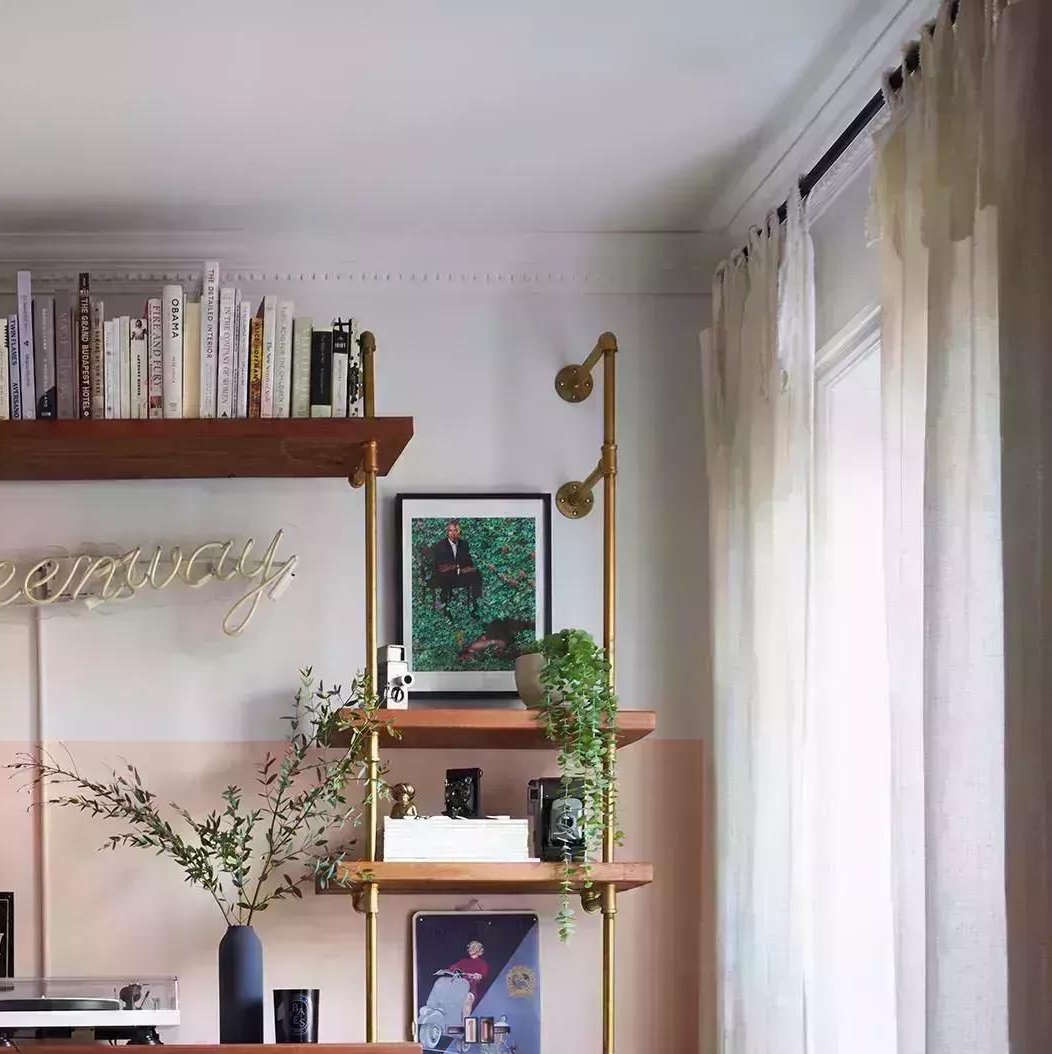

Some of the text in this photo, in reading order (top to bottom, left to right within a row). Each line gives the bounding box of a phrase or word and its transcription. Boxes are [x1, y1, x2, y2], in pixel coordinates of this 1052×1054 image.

[171, 298, 179, 339] OBAMA
[223, 315, 231, 330] THE
[224, 306, 231, 314] IN
[81, 315, 89, 342] GRAND
[152, 305, 162, 387] FIRE AND FURY
[222, 366, 229, 377] OF
[82, 386, 90, 411] HOTEL
